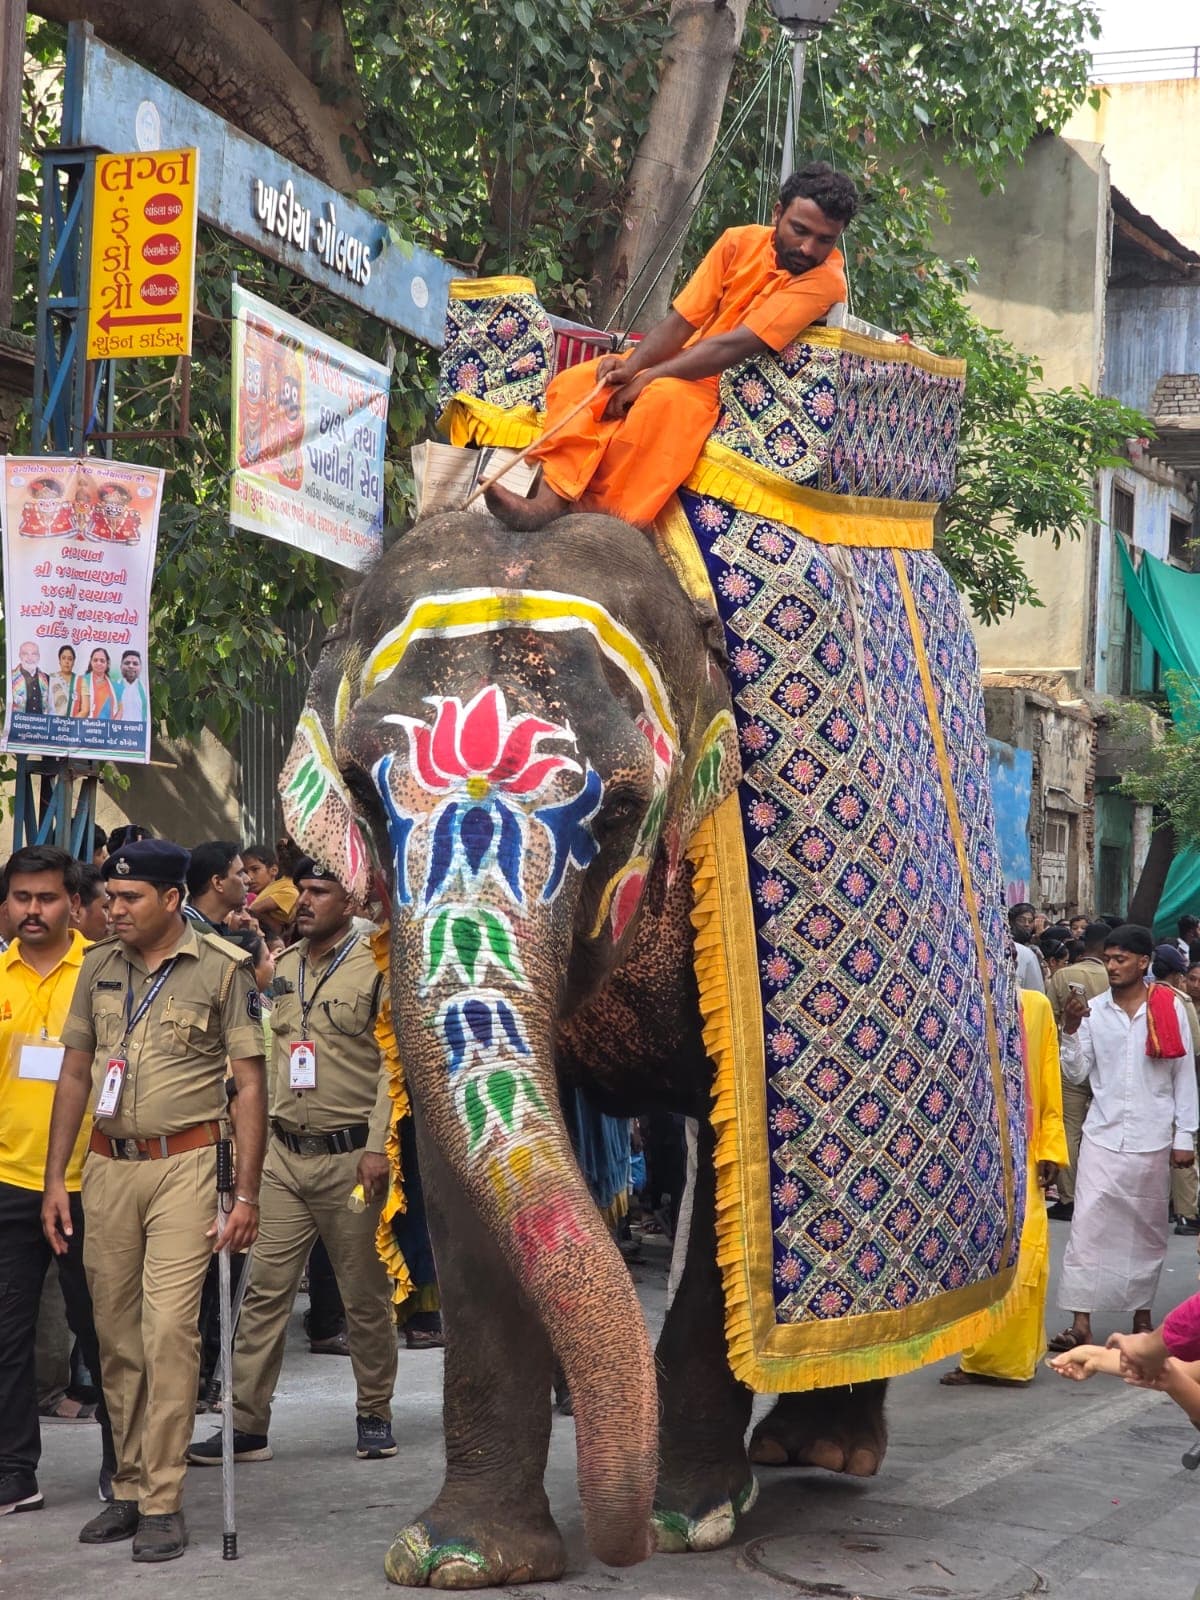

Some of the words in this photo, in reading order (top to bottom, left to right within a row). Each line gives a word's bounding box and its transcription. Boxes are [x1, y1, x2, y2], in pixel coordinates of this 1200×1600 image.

[101, 153, 190, 191] લગ્ન
[257, 179, 310, 252] ખાડીયા
[316, 202, 371, 285] ગોલવાડ
[97, 335, 133, 355] શુકન
[354, 426, 377, 459] તથા
[306, 443, 354, 491] પાણીની
[61, 546, 104, 562] ભગવાન
[33, 561, 52, 577] શ્રી
[55, 565, 128, 586] જગન્નાથજીની
[78, 591, 122, 604] રથયાત્રા
[19, 600, 55, 617] પ્રસંગે
[77, 607, 138, 626] નગરજનોને
[36, 621, 69, 638] હાર્દિક
[72, 626, 131, 645] શુભેચ્છાઓ
